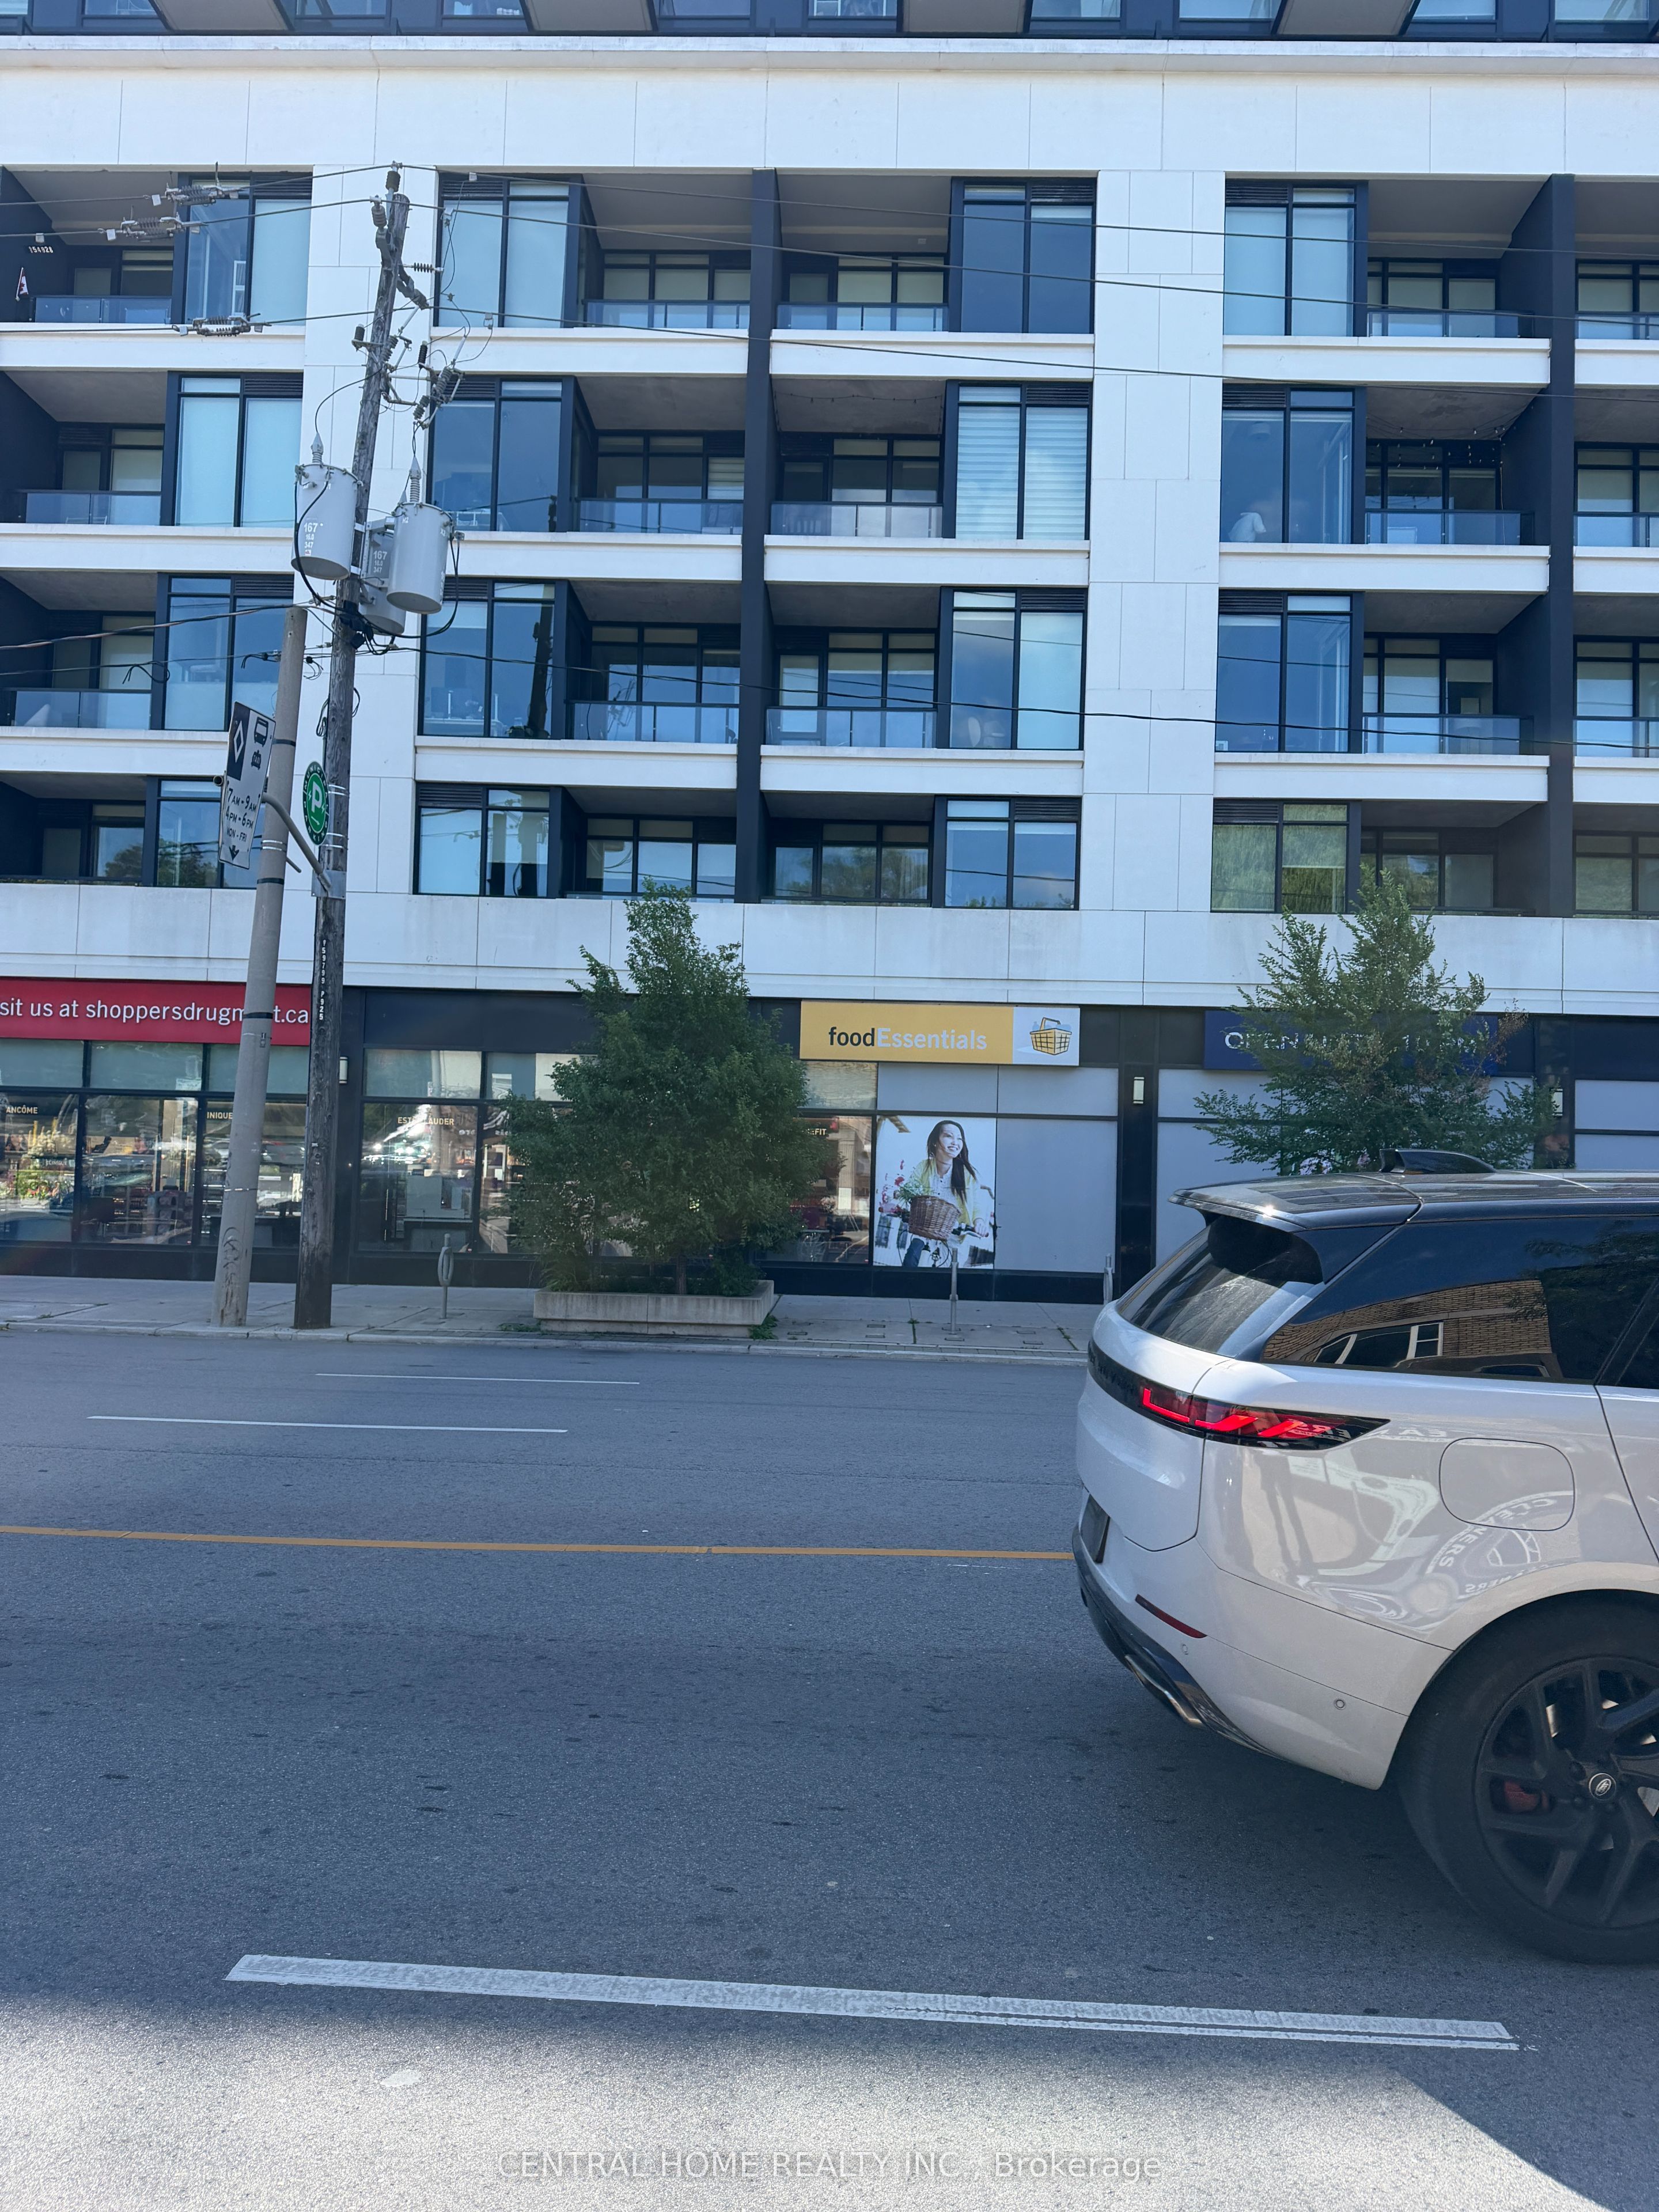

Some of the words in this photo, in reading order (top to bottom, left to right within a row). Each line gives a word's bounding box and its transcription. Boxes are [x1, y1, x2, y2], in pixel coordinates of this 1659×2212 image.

[304, 522, 318, 533] 167
[373, 551, 388, 560] 167
[311, 781, 323, 813] P
[239, 832, 248, 842] FRI
[31, 1002, 53, 1017] us
[59, 1000, 79, 1018] at
[86, 999, 309, 1025] shoppersdrugmt.ca
[6, 1105, 38, 1114] ANCÔME
